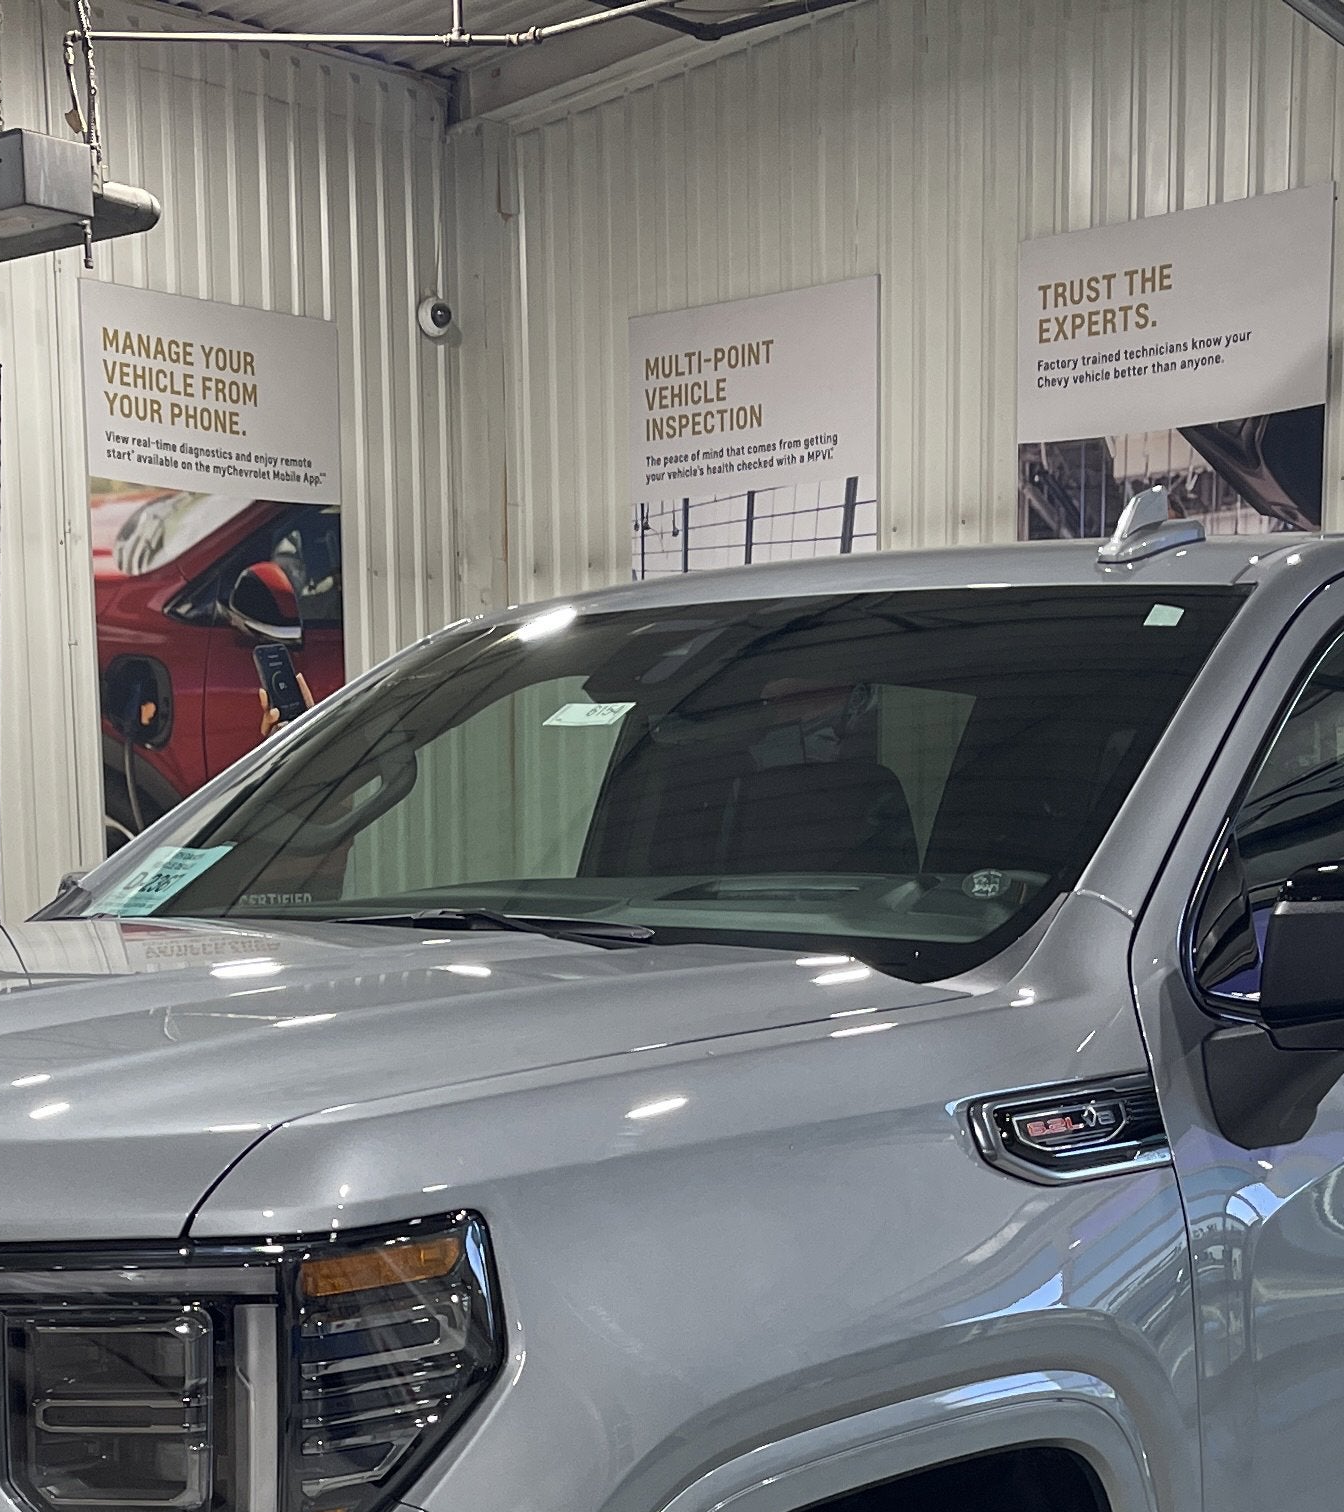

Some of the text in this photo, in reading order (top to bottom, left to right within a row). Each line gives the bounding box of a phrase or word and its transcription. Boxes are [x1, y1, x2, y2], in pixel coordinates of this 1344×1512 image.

[1038, 263, 1173, 310] TRUST THE
[1038, 302, 1157, 344] EXPERTS.
[102, 327, 255, 377] MANAGE YOUR
[645, 339, 774, 381] MULTI-POINT
[1037, 329, 1252, 373] Factory trained technicians know your
[102, 358, 258, 407] VEHICLE FROM
[1037, 354, 1224, 389] Chevy vehicle better than anyone.
[104, 391, 247, 436] YOUR PHONE.
[644, 377, 727, 411] VEHICLE
[646, 404, 763, 441] INSPECTION
[105, 430, 313, 469] View real-time diagnostics and enjoy remote
[136, 451, 179, 469] available
[181, 460, 193, 471] on
[195, 461, 211, 473] the
[213, 464, 271, 480] myChevrolet
[273, 470, 301, 483] Mobile
[645, 471, 666, 485] your
[667, 465, 705, 479] vehicle's
[706, 462, 734, 475] health
[736, 458, 774, 472] checked
[776, 454, 797, 467] with
[799, 455, 805, 464] a
[646, 433, 838, 468] The peace of mind that comes from getting
